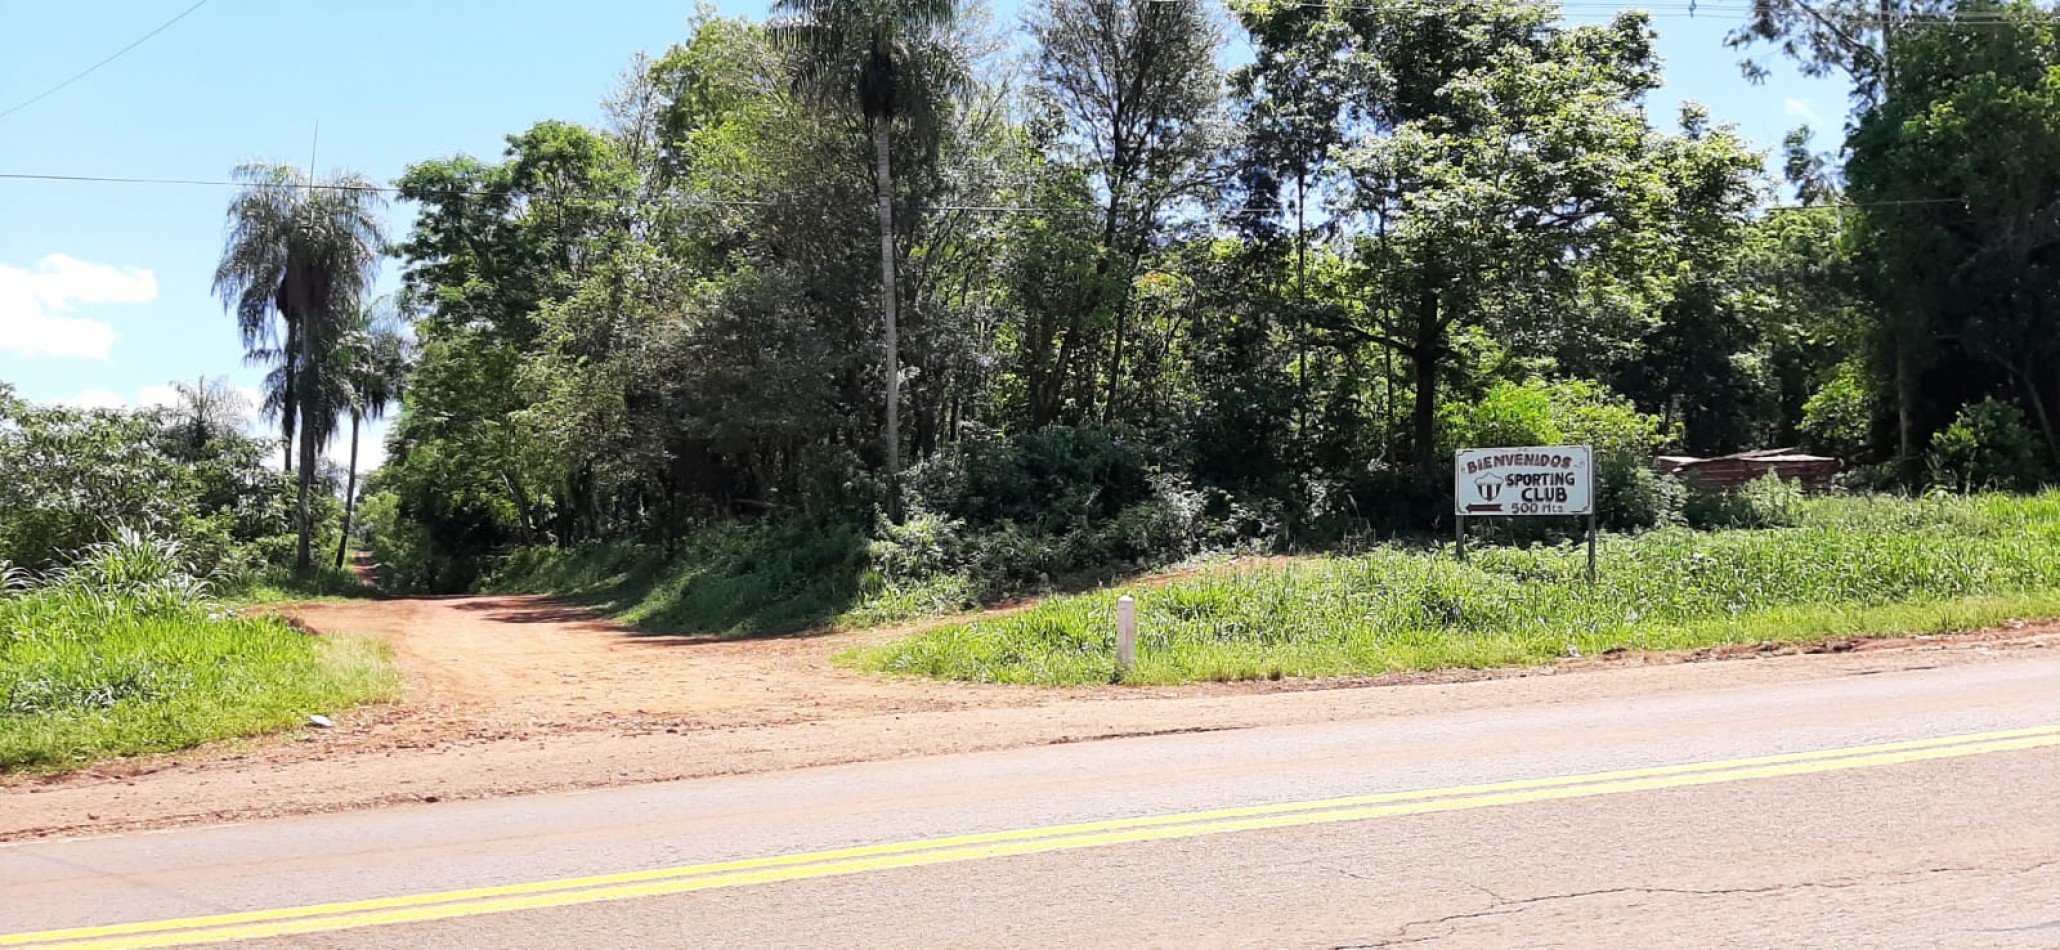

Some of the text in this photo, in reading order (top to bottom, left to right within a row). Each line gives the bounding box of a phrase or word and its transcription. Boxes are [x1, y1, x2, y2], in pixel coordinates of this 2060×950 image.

[1467, 453, 1572, 474] BIENVENIDOS
[1505, 472, 1575, 486] SPORTING
[1521, 487, 1567, 502] CLUB
[1511, 502, 1538, 514] 500
